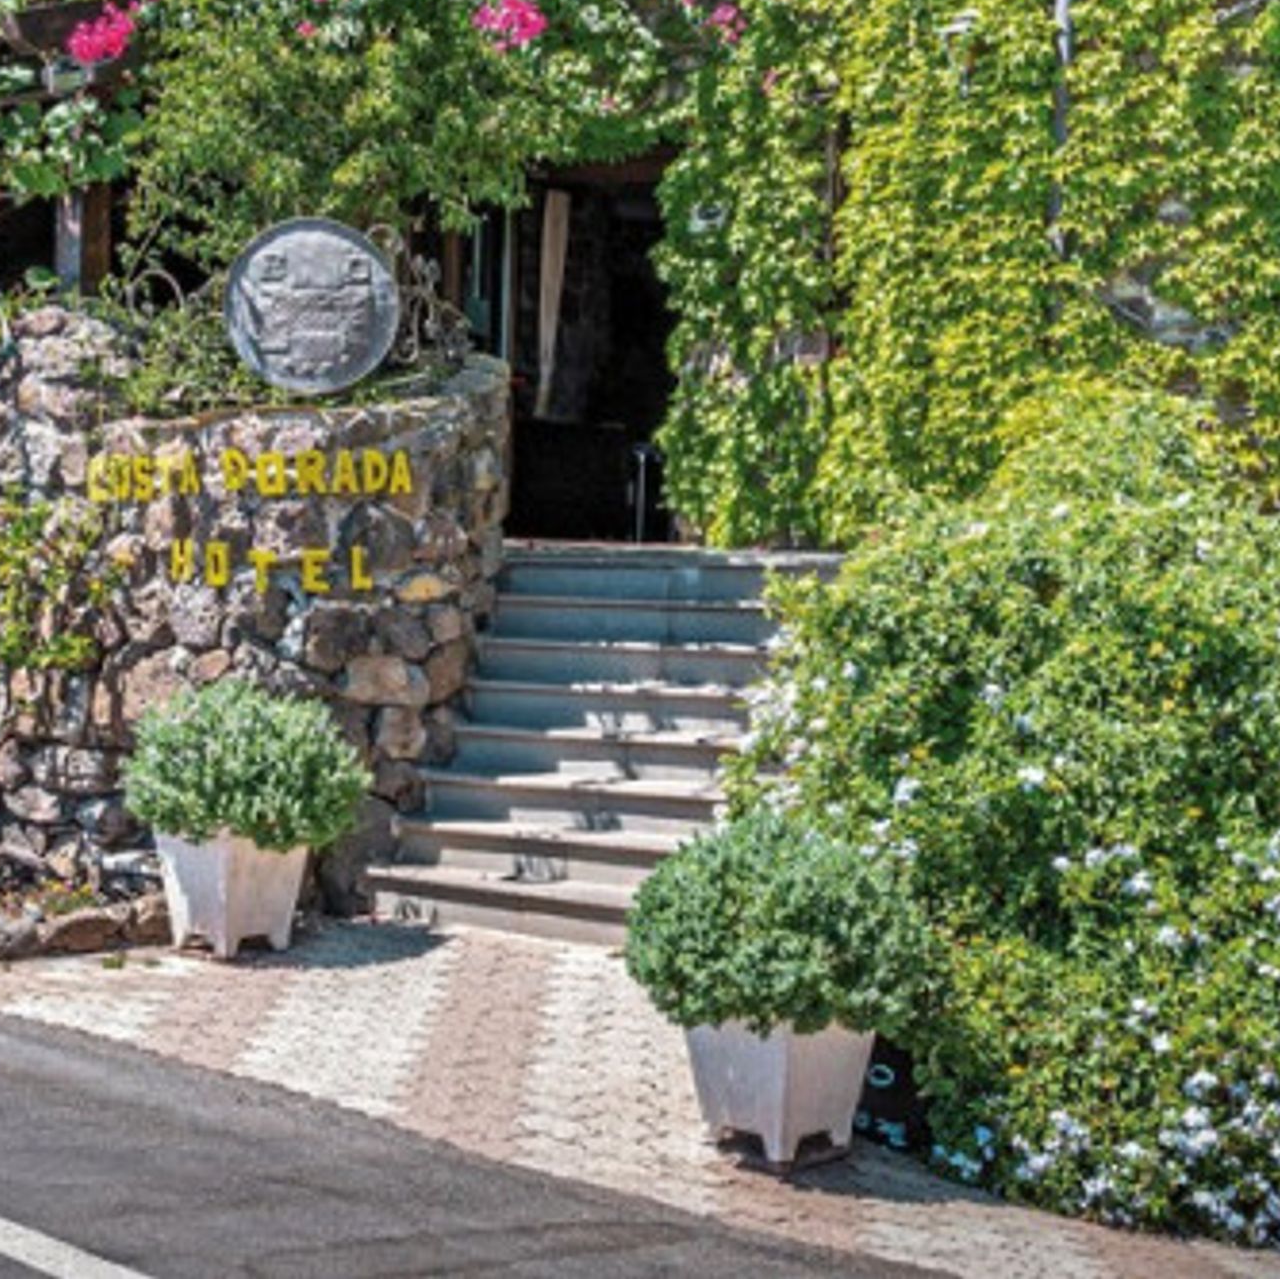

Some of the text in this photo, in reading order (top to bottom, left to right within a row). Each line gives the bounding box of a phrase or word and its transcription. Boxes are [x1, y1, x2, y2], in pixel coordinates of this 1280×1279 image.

[87, 448, 412, 503] COSTA DORADA
[171, 537, 374, 595] HOTEL
